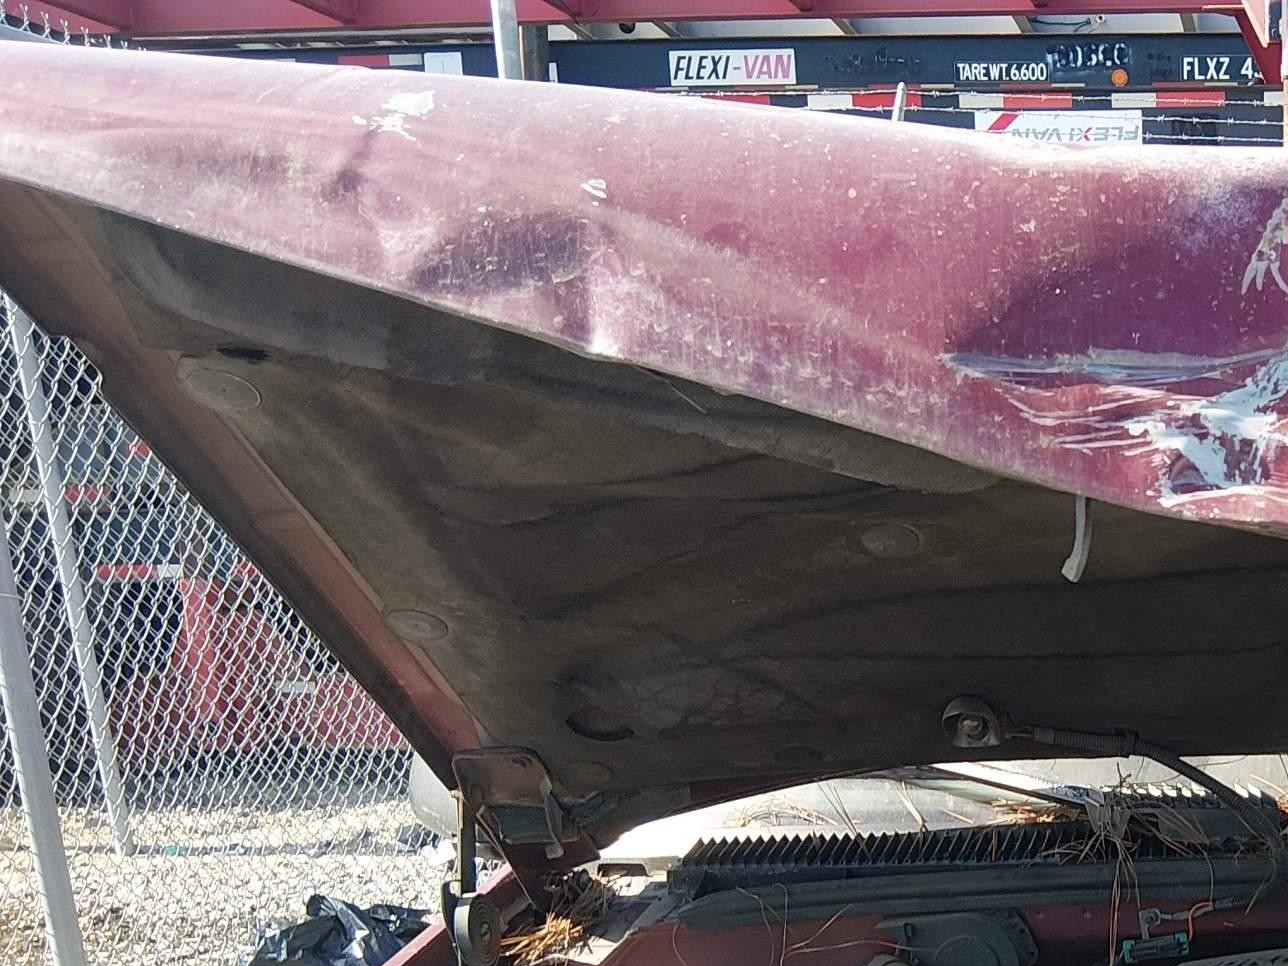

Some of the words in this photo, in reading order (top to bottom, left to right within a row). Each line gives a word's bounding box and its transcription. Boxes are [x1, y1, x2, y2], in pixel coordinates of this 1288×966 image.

[957, 63, 988, 81] TARE
[989, 63, 1010, 81] WT.
[1183, 57, 1230, 80] FLXZ
